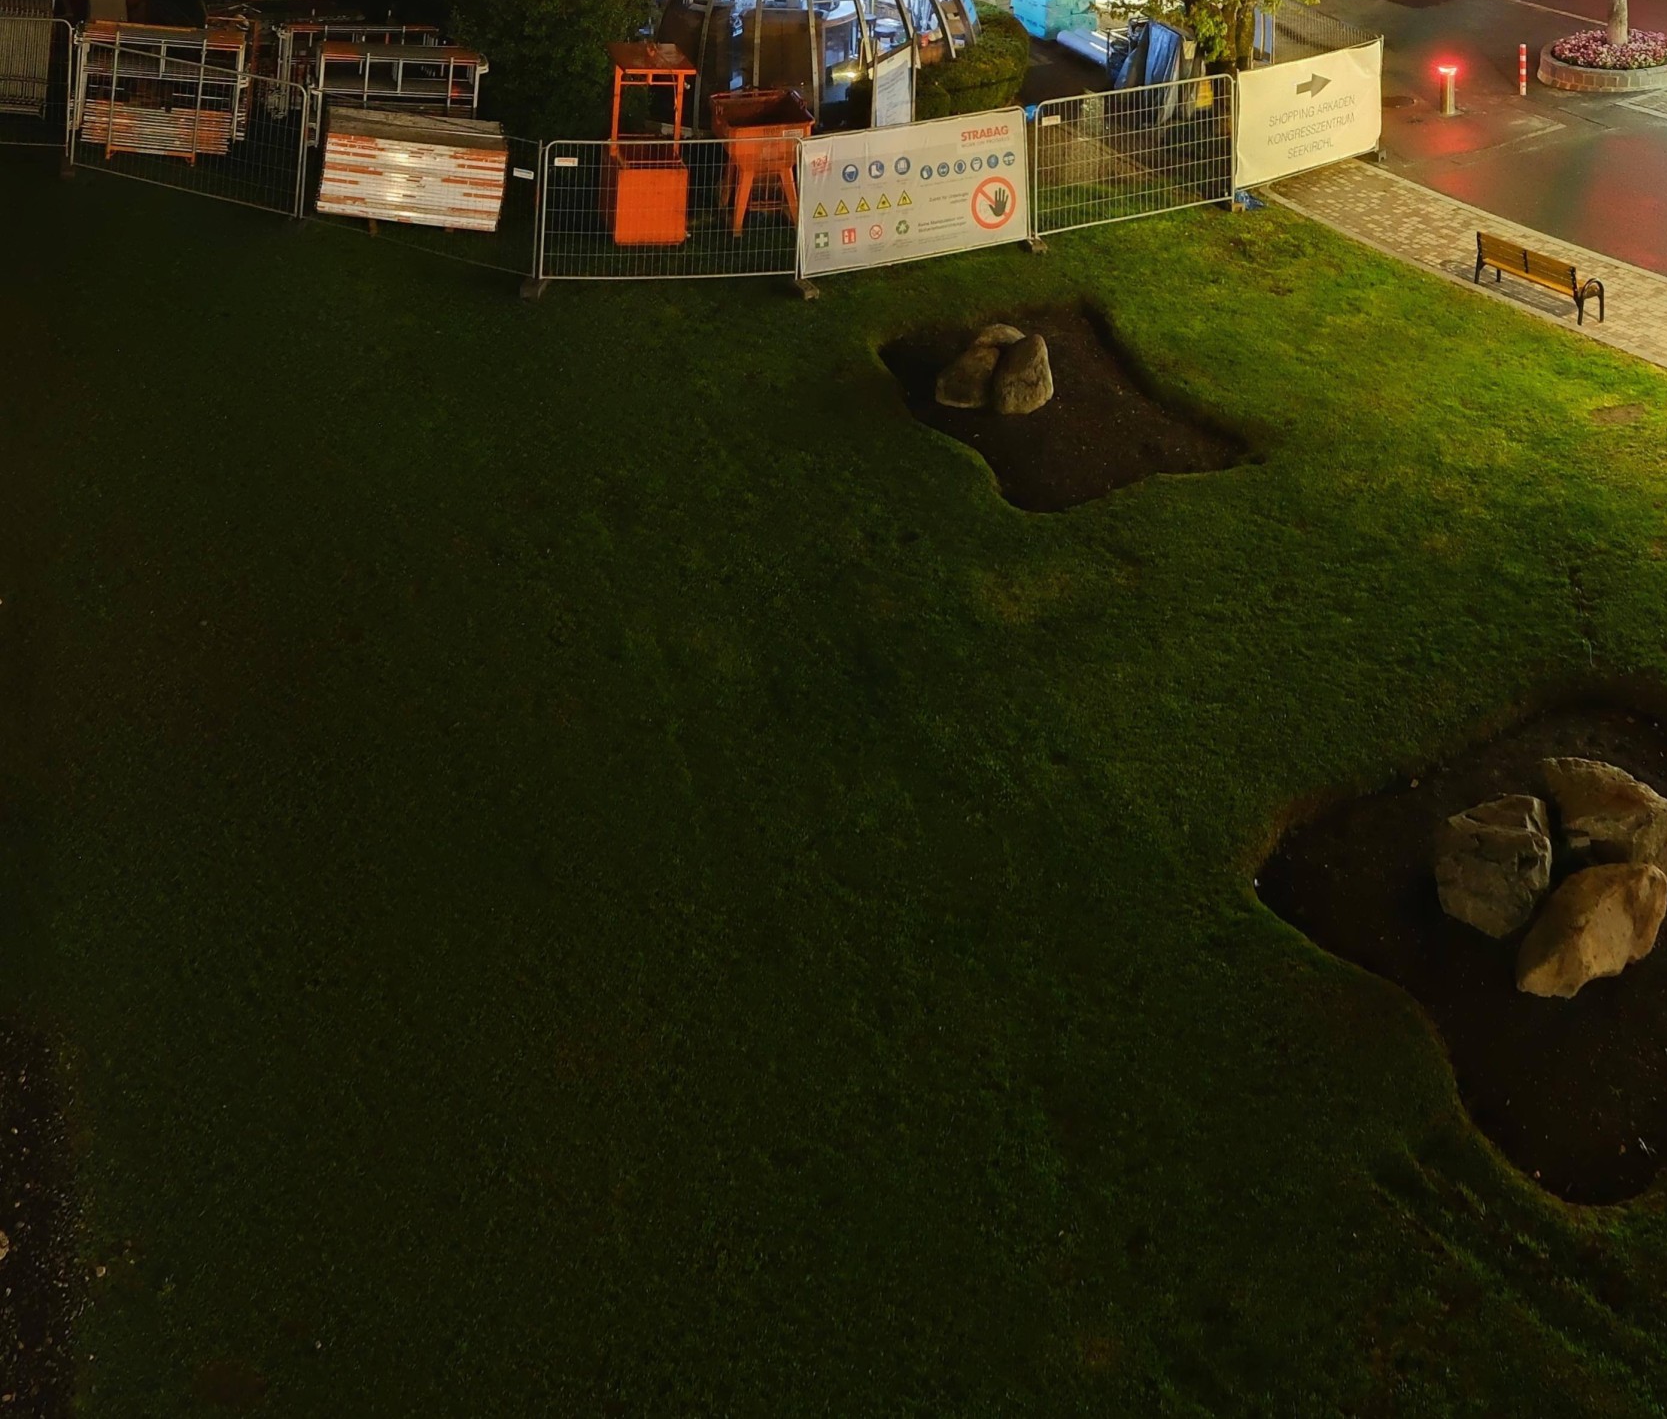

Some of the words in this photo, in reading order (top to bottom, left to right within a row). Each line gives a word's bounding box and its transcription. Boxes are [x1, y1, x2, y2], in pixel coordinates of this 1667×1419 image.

[1268, 106, 1315, 127] SHOPPING
[1317, 94, 1355, 114] ARKADEN
[961, 125, 1008, 141] STRABAG
[1267, 112, 1355, 146] KONGRESSZENTRUM
[1287, 138, 1334, 159] SEEKIRCHL
